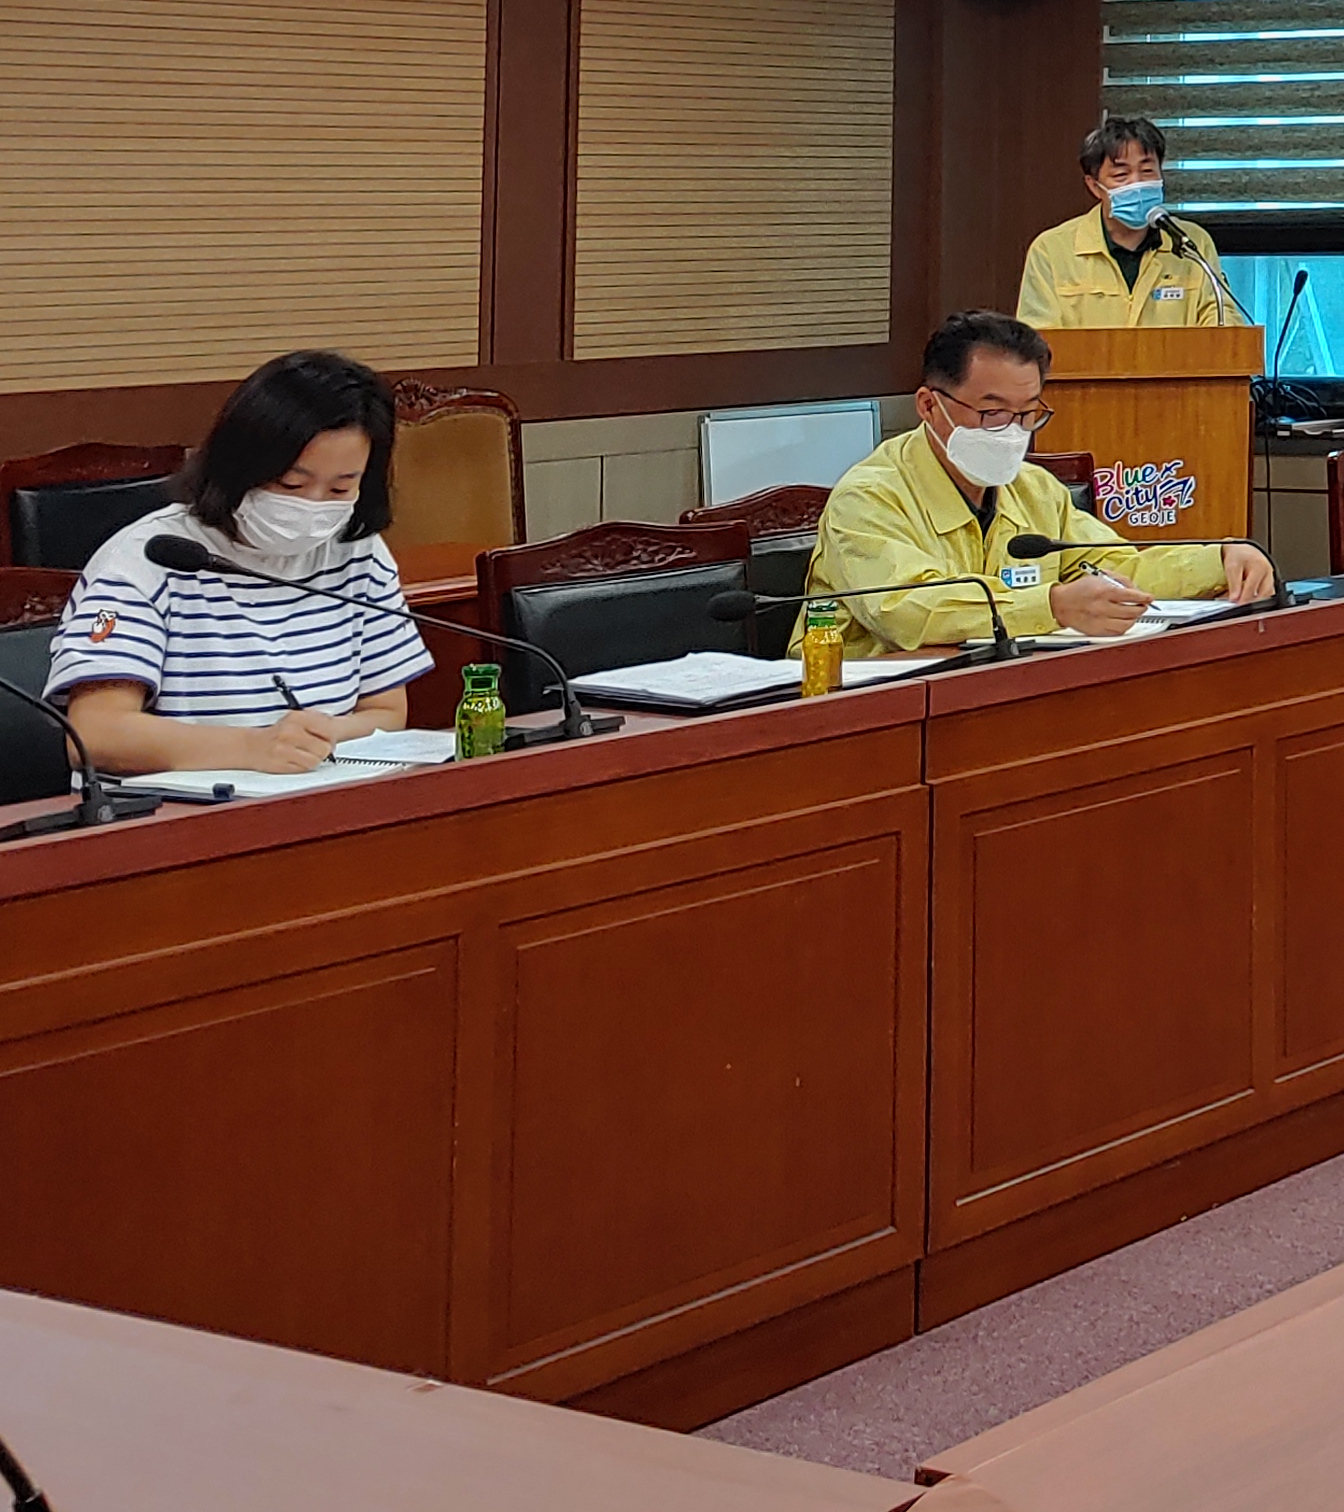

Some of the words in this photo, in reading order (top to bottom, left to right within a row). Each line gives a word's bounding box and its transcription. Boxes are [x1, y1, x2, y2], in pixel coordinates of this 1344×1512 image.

[1094, 461, 1159, 497] Blue
[1104, 484, 1159, 520] City
[1129, 510, 1175, 525] GEOJE
